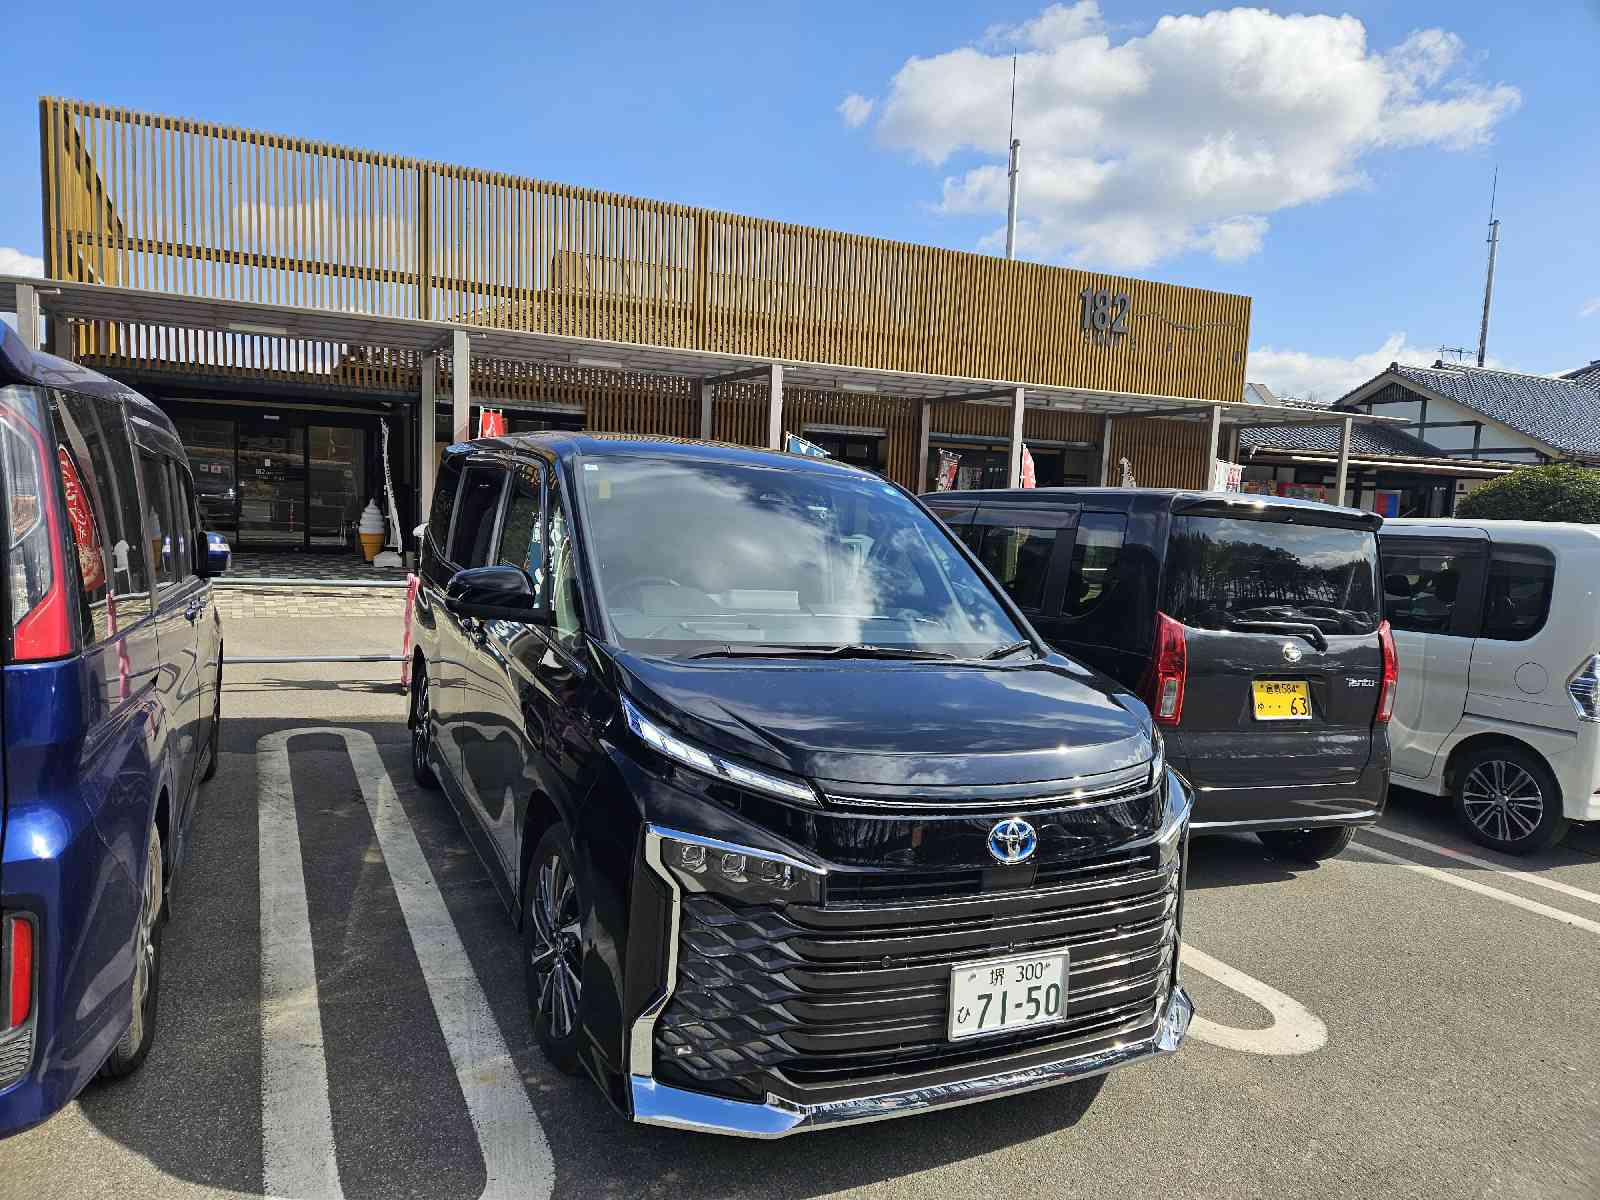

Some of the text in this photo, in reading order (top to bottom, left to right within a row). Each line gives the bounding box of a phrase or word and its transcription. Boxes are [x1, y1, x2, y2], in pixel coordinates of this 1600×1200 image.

[1080, 287, 1131, 333] 182
[990, 962, 1044, 986] 堺 300
[957, 983, 1060, 1029] ひ 71-50
